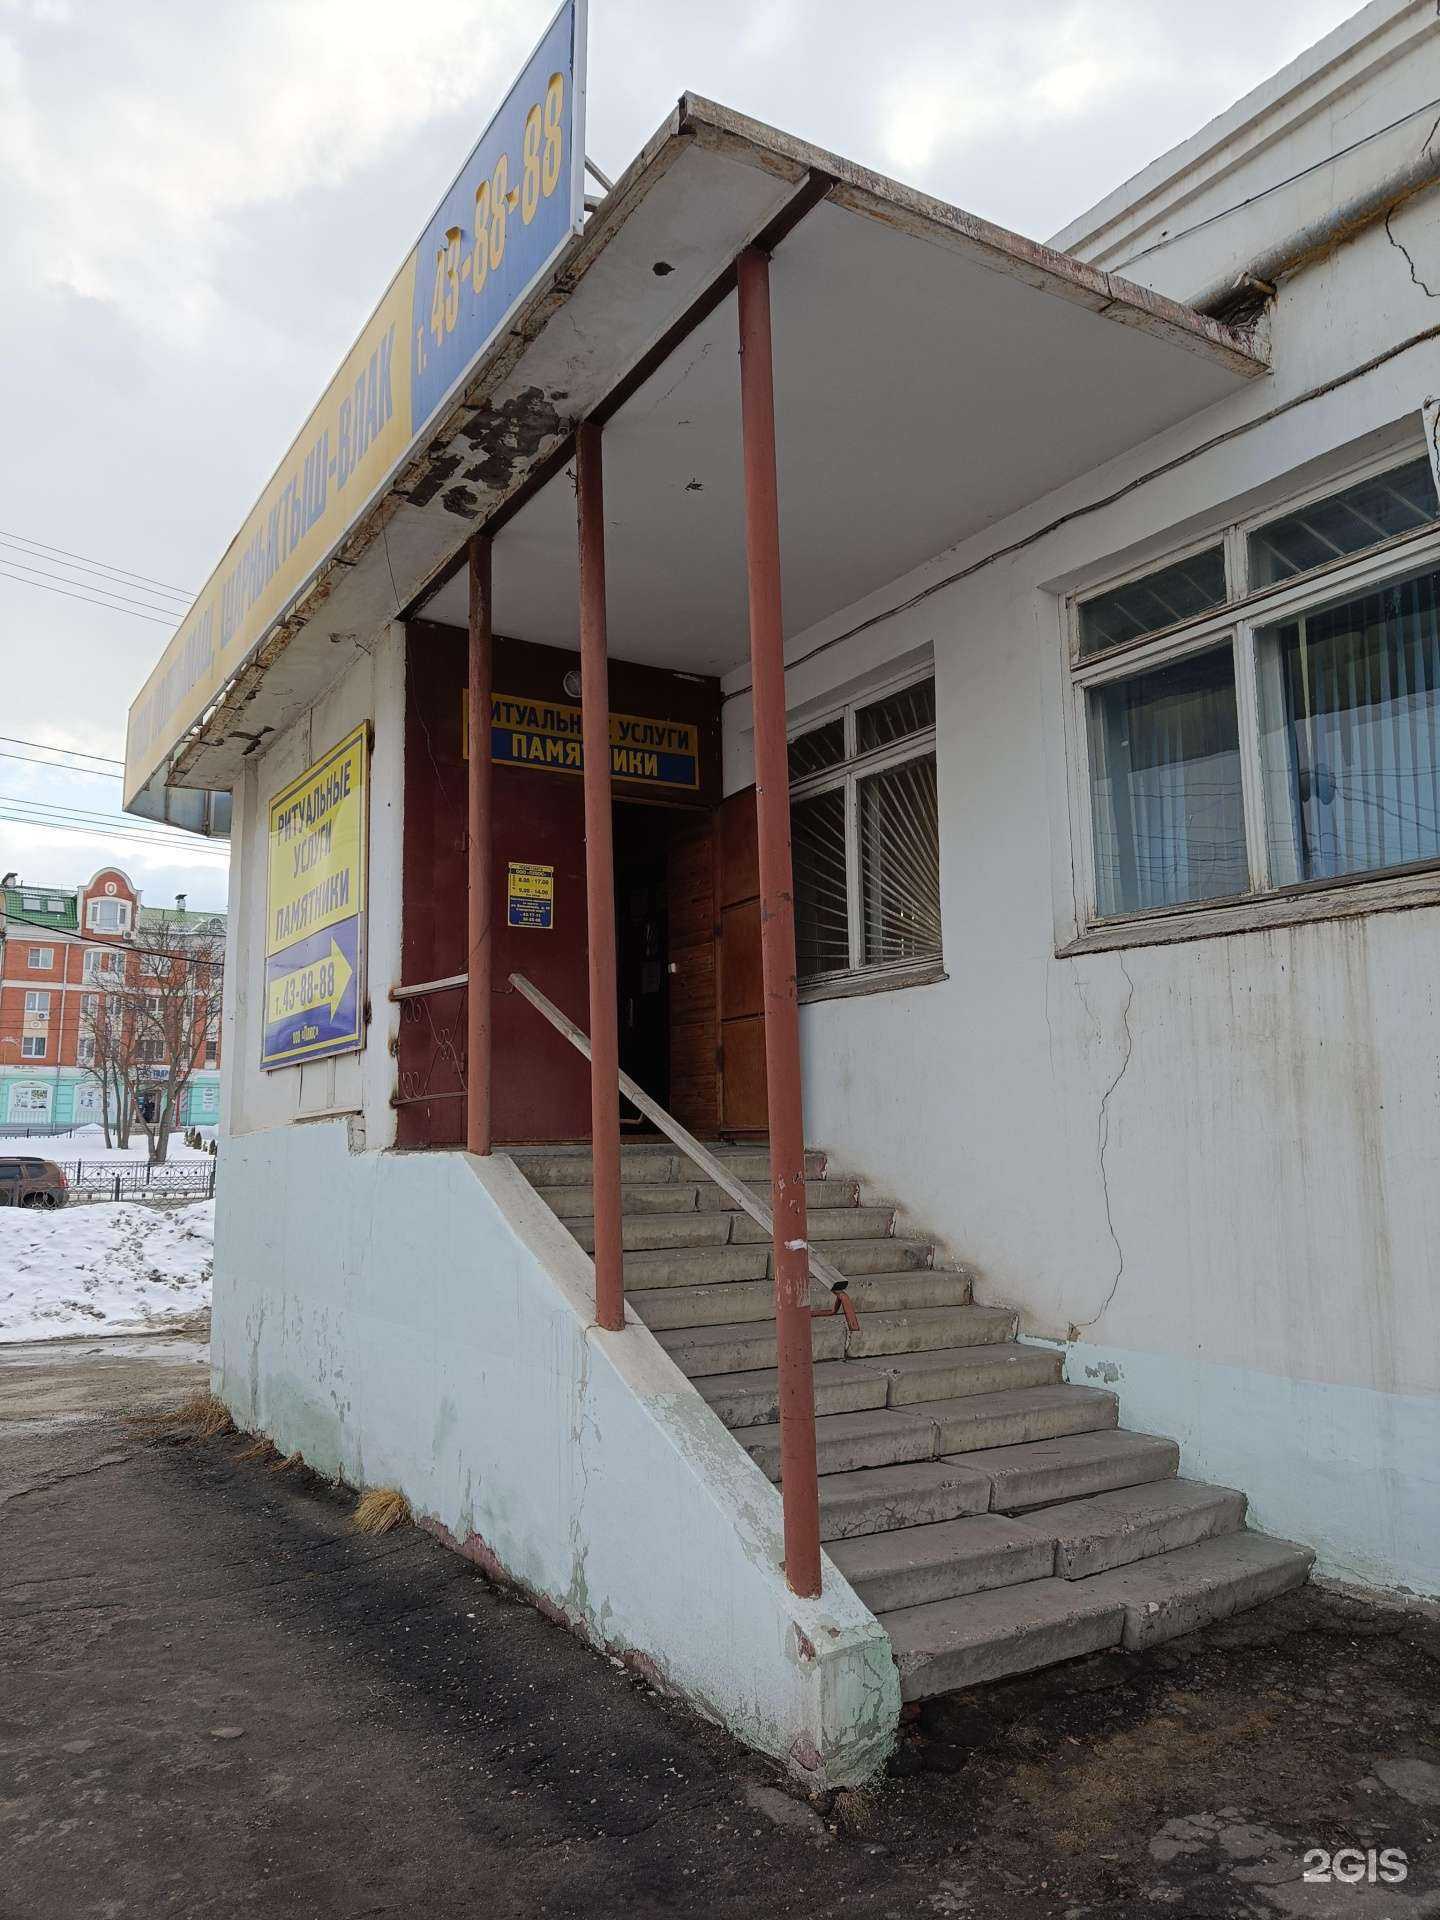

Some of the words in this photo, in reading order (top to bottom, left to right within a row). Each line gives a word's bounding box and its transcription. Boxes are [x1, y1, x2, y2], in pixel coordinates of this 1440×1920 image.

[431, 72, 564, 347] 43-88-88
[619, 720, 689, 749] УСЛУГИ
[277, 759, 352, 847] РИТУАЛЬНЫЕ
[293, 819, 333, 879] УСЛУГИ
[275, 867, 350, 942] ПАМЯТНИКИ
[283, 961, 334, 1012] 43-88-88
